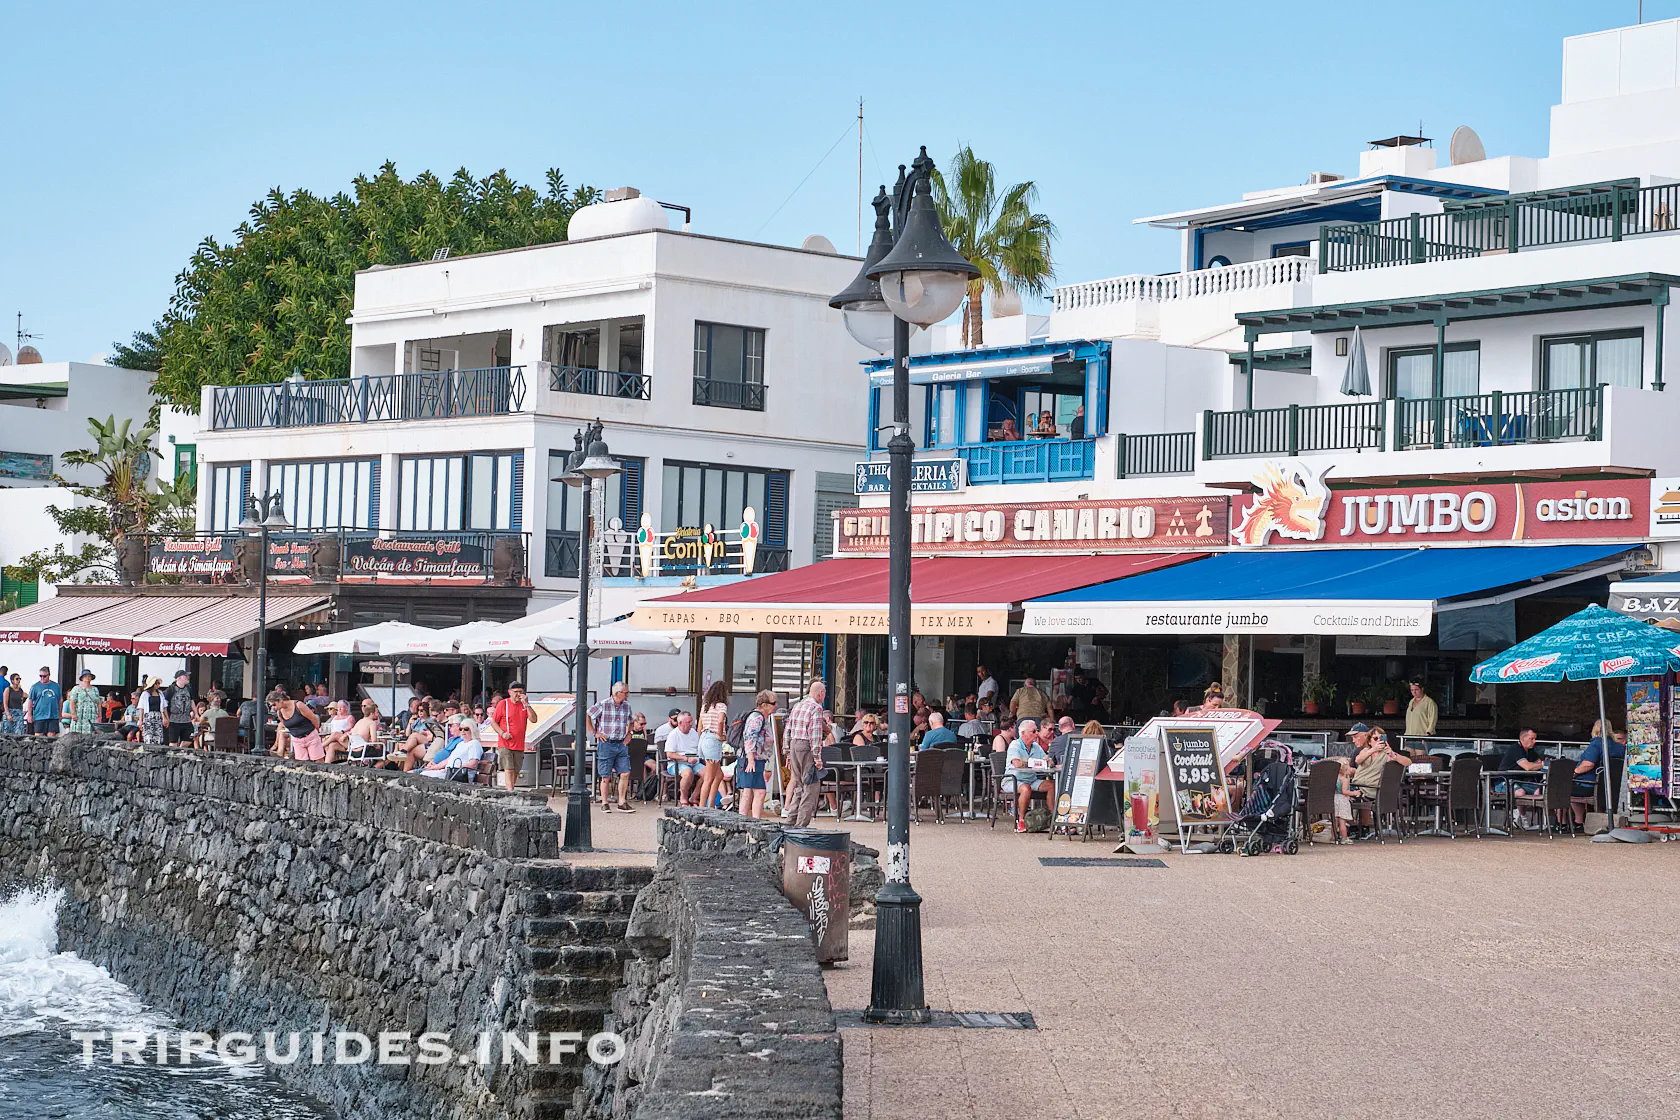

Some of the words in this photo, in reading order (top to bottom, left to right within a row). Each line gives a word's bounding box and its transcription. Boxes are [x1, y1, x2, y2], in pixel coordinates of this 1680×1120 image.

[932, 373, 962, 381] Galeria
[966, 370, 982, 378] Bar
[868, 465, 887, 475] THE
[1340, 491, 1496, 536] JUMBO
[1536, 490, 1632, 522] asian
[843, 516, 890, 536] GRIL
[1013, 505, 1156, 541] CANARIO
[164, 537, 204, 553] Restaurante
[204, 536, 222, 555] Grill
[372, 537, 434, 553] Restaurante
[435, 540, 461, 555] Grill
[849, 537, 890, 546] RESTAURA
[151, 556, 177, 574] Volcán
[177, 556, 188, 573] de
[188, 555, 233, 576] Timanfaya
[351, 556, 395, 572] Volcán
[397, 557, 411, 573] de
[414, 558, 480, 577] Timanfaya
[1621, 597, 1680, 613] BAZ
[662, 613, 696, 624] TAPAS
[719, 613, 740, 625] BBQ
[766, 614, 823, 626] COCKTAIL
[920, 616, 943, 627] TEX
[948, 616, 974, 627] MEX
[1034, 616, 1046, 626] We
[1048, 616, 1066, 626] love
[1146, 613, 1222, 626] restaurante
[1226, 611, 1269, 629] jumbo
[1313, 615, 1358, 626] Cocktails
[1361, 616, 1382, 626] and
[1602, 657, 1634, 674] Kalise
[1183, 739, 1209, 751] jumbo
[1174, 753, 1213, 766] Cocktail
